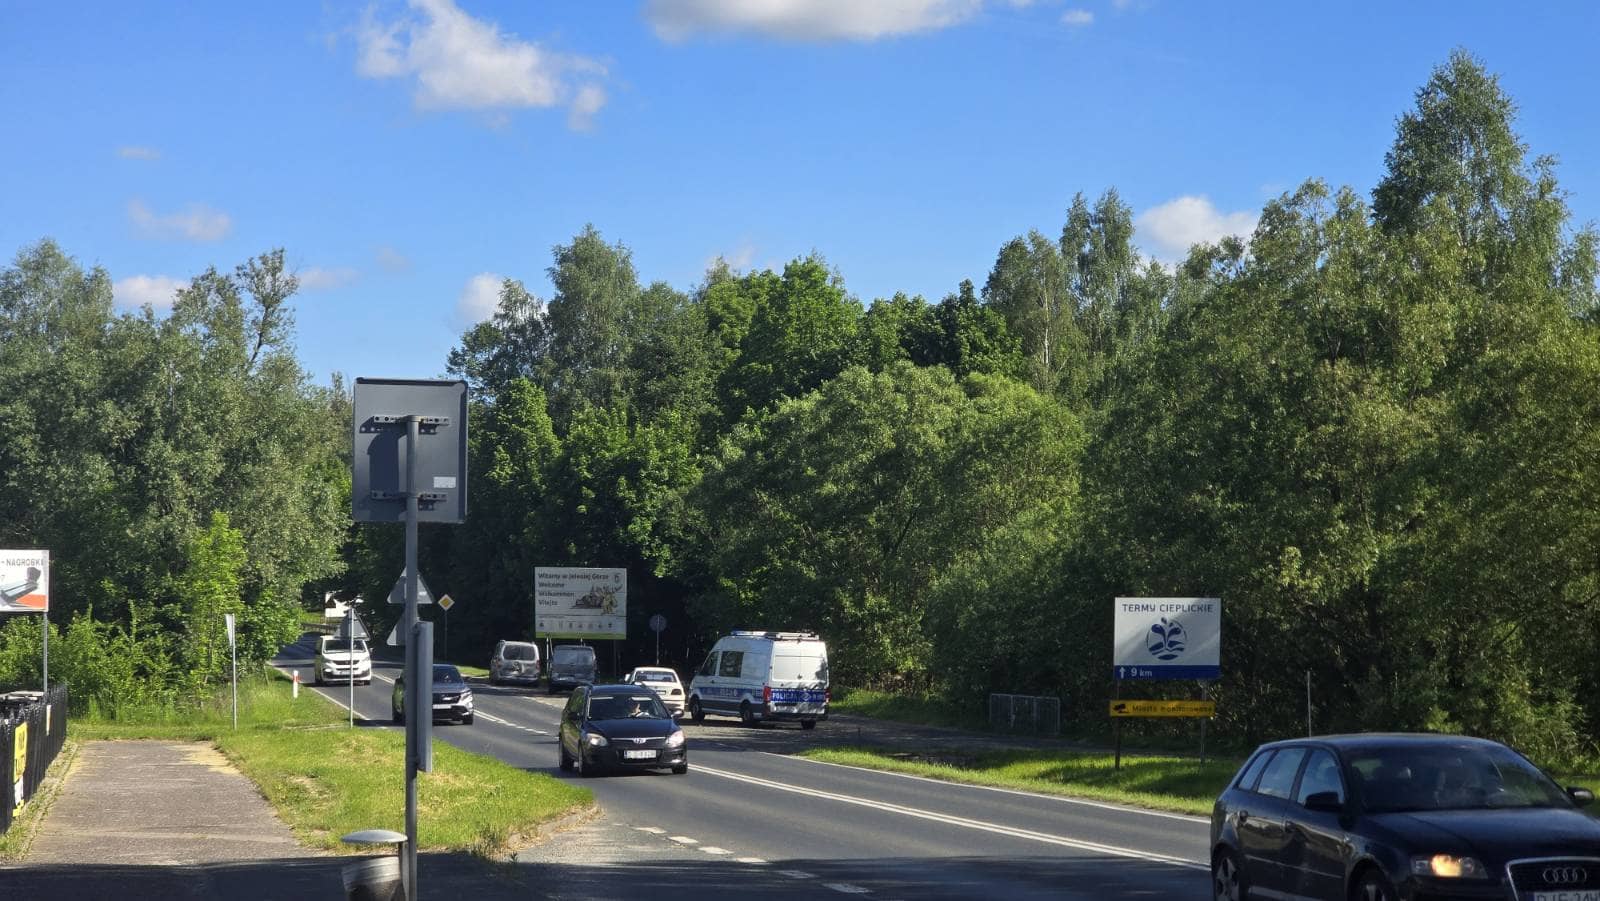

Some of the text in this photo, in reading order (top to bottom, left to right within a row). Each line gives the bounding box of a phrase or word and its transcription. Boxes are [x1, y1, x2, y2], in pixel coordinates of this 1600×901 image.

[538, 572, 560, 580] Witamy
[1121, 603, 1214, 613] TERMY CIEPLICKIE
[1130, 667, 1153, 677] 9 km
